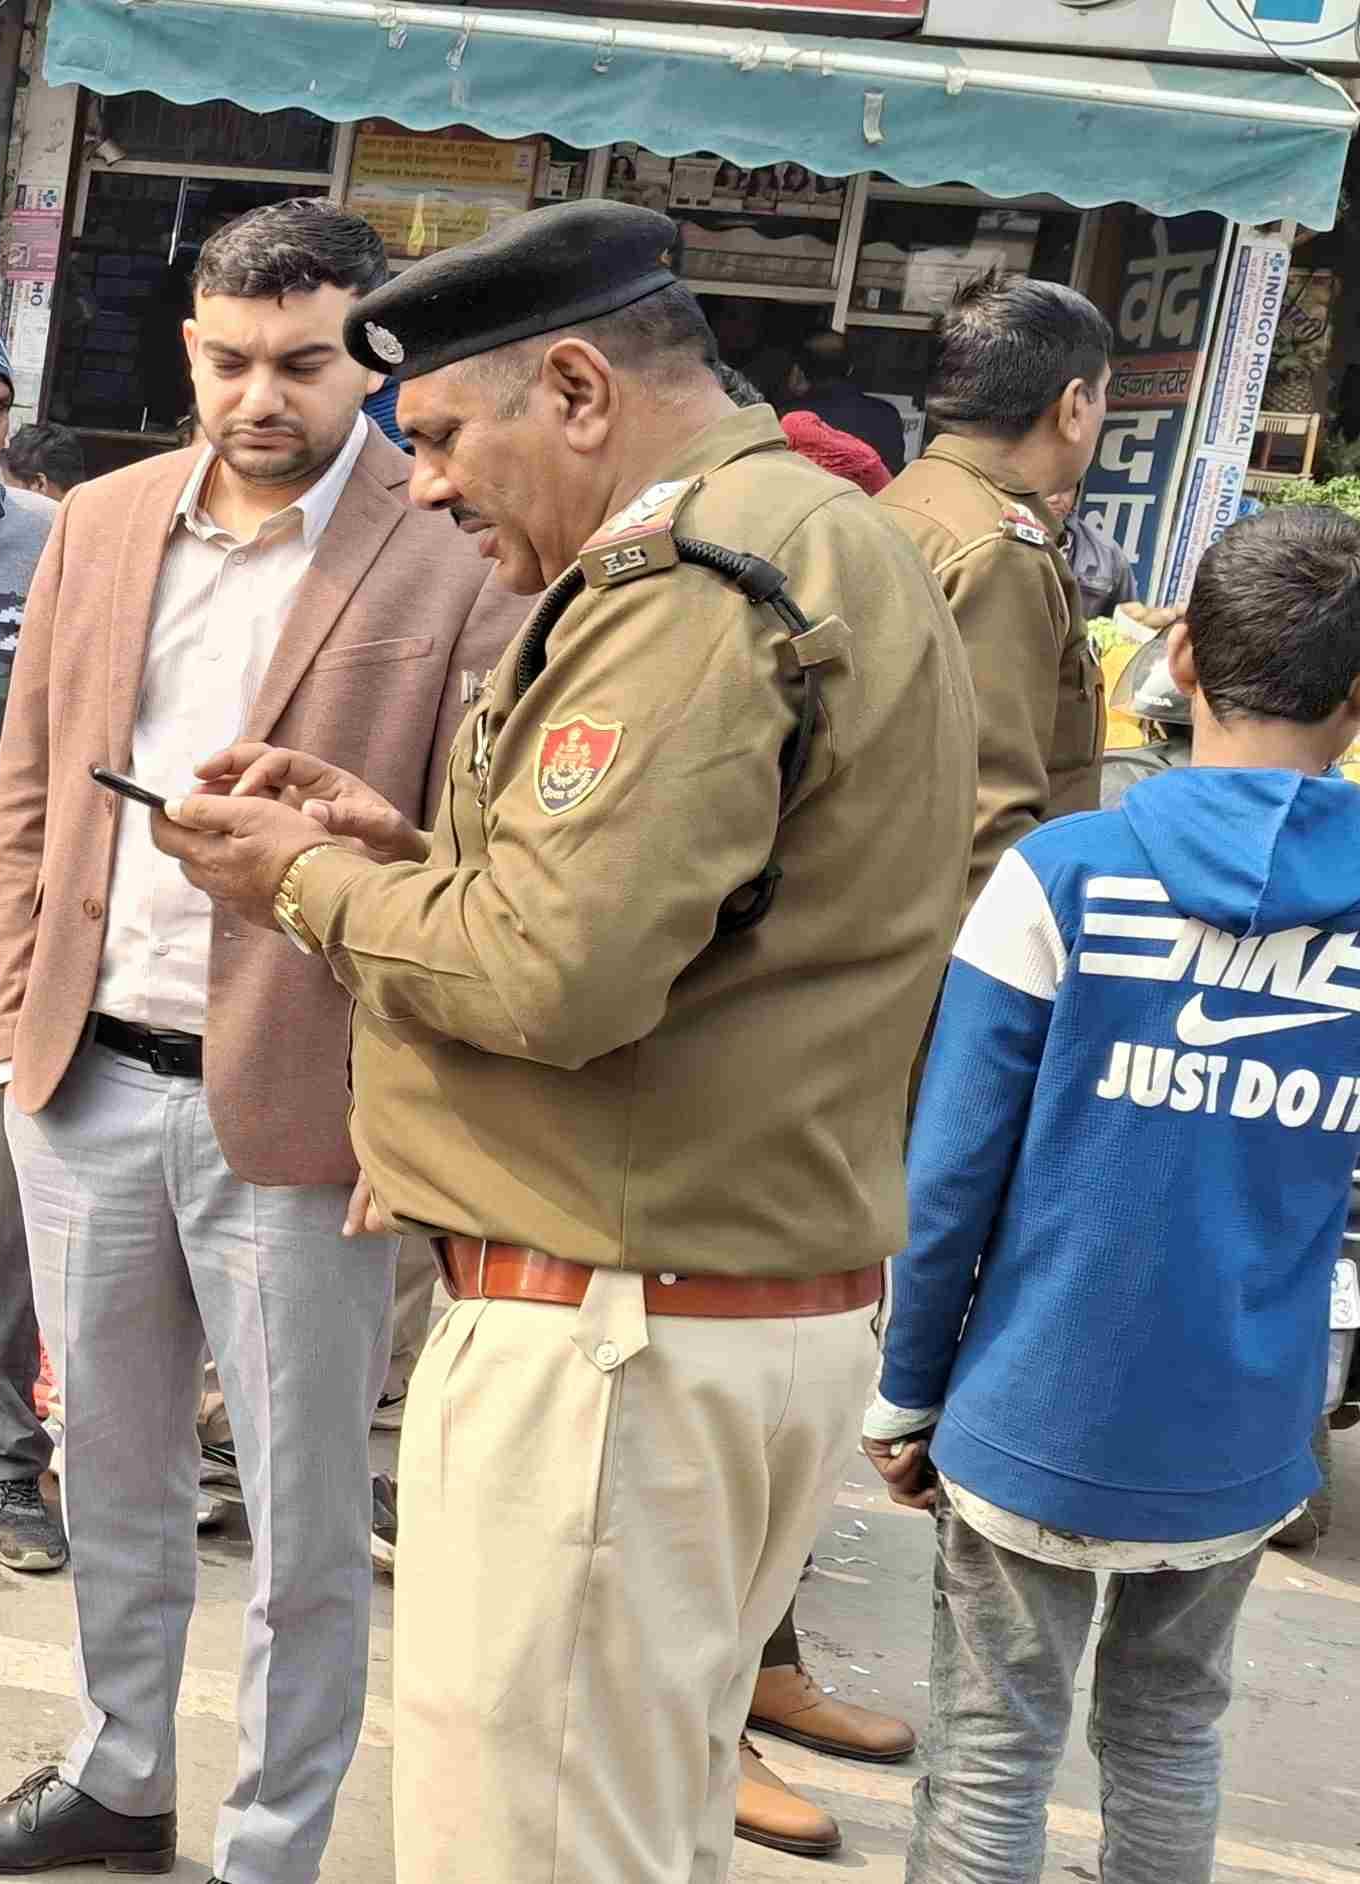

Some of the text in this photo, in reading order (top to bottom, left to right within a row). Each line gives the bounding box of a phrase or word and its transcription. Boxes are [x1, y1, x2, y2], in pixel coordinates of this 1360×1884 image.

[1234, 275, 1283, 446] INDIGO HOSPITAL
[1210, 488, 1236, 543] INDIG
[1096, 1041, 1360, 1133] JUST DO IT
